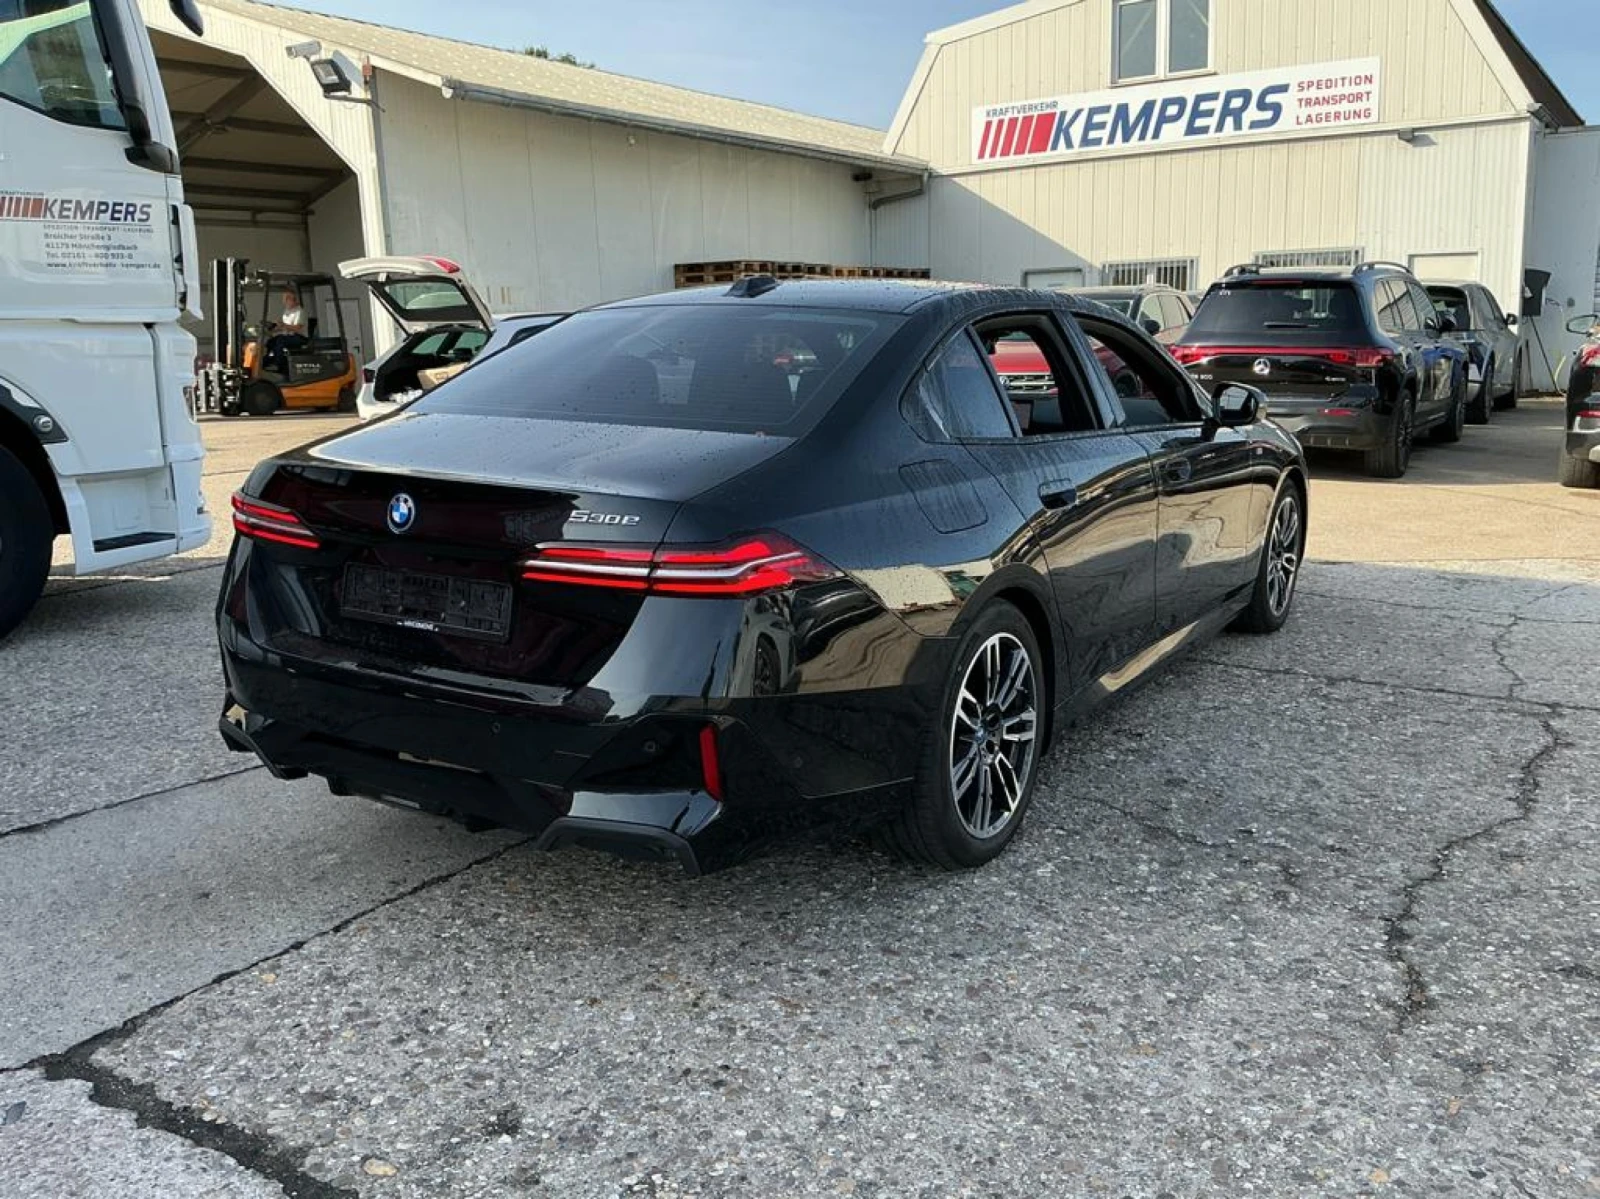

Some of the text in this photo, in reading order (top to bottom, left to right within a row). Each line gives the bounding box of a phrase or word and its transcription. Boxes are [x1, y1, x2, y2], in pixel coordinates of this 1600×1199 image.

[1296, 74, 1373, 92] SPEDITION
[1296, 90, 1373, 109] TRANSPORT
[985, 100, 1059, 118] KRAFTVERKEHR
[1049, 83, 1290, 152] KEMPERS
[1296, 108, 1372, 126] LAGERUNG
[42, 198, 152, 222] KEMPERS
[568, 510, 640, 525] 530e
